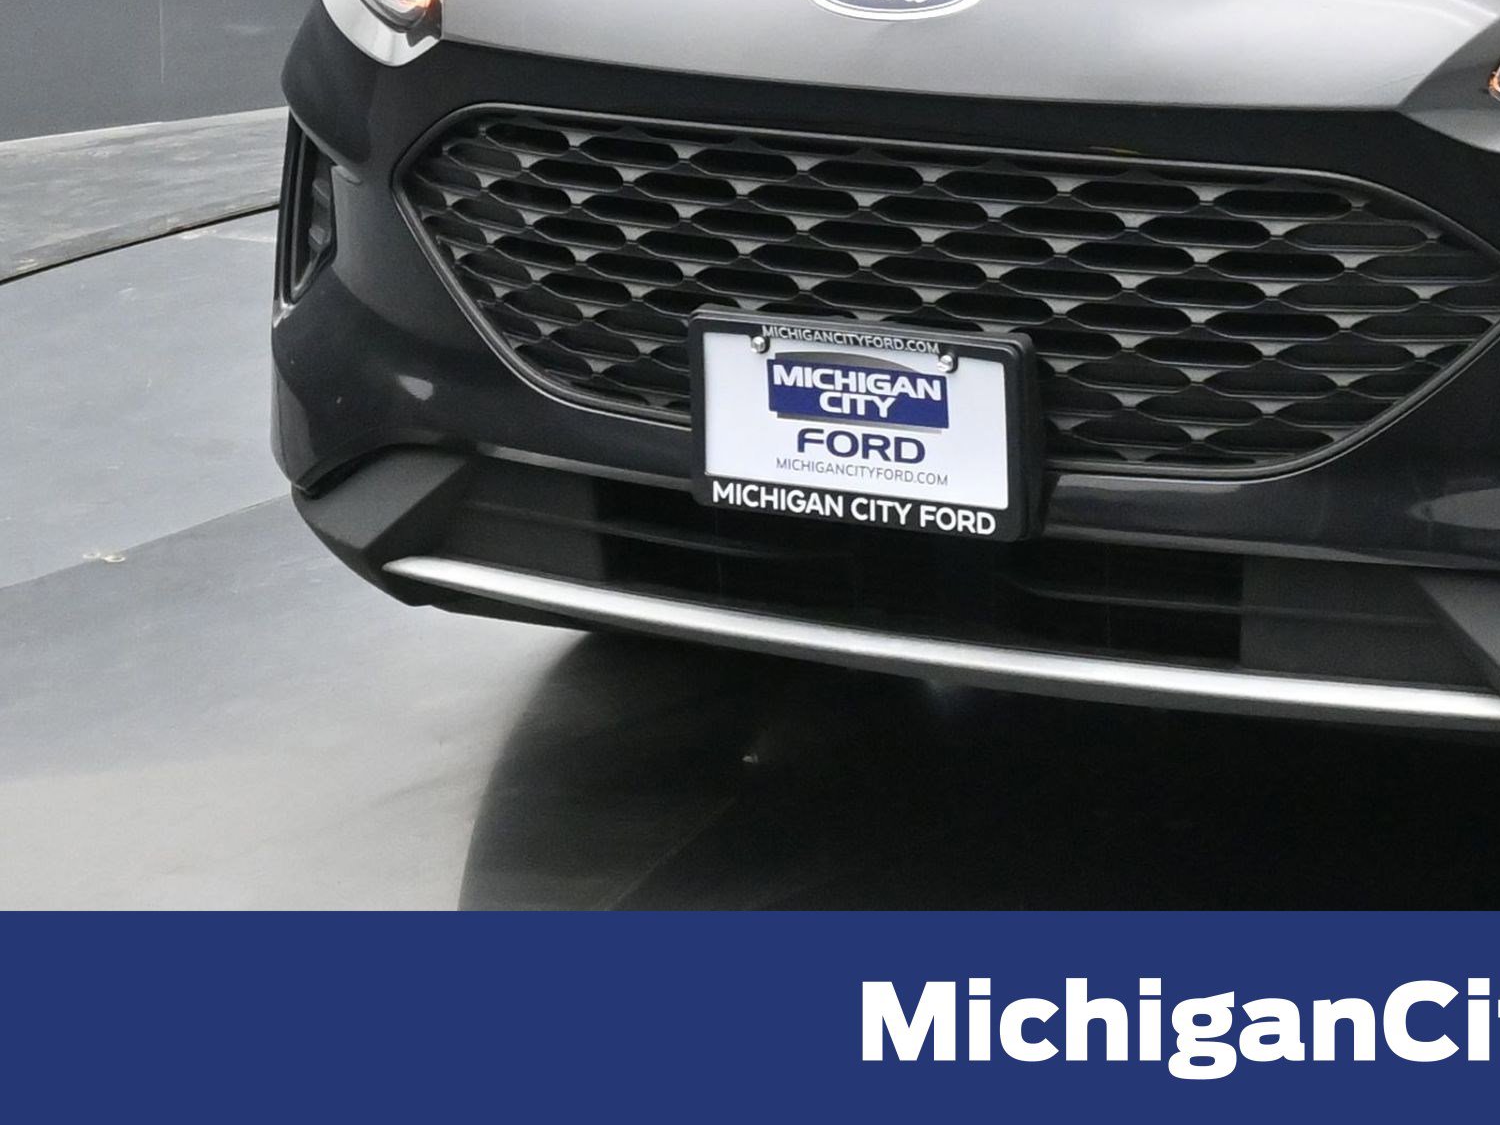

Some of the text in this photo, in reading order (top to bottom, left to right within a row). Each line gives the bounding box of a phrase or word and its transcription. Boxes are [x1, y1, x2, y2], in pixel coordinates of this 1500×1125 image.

[762, 325, 940, 354] MICHIGANCITYFORD.COM
[772, 364, 942, 401] MICHIGAN
[819, 391, 896, 418] CITY
[797, 427, 926, 464] FORD
[776, 458, 949, 486] MICHIGANCITYFORD.COM
[712, 481, 997, 535] MICHIGAN CITY FORD
